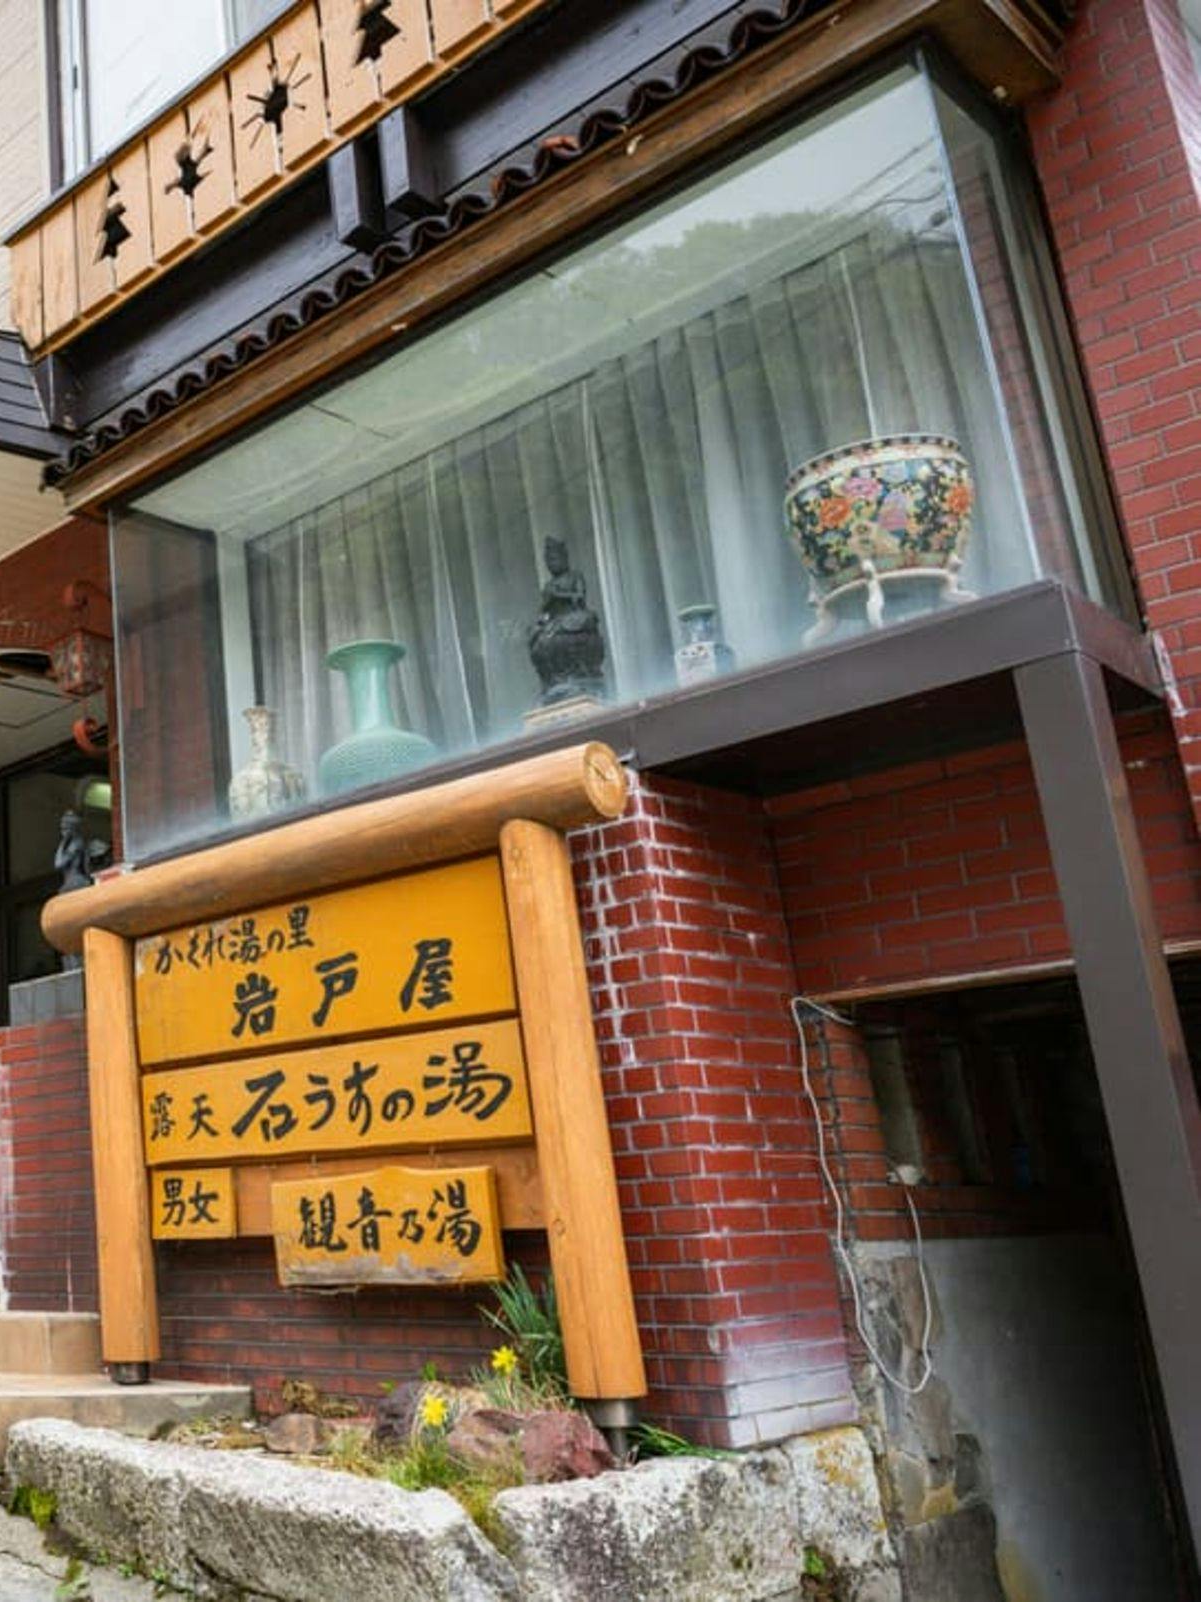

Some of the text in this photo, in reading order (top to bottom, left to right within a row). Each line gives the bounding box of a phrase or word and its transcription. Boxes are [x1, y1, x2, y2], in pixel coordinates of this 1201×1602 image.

[155, 905, 314, 975] かくれ湯の里
[231, 938, 454, 1039] 岩戸屋
[161, 1177, 220, 1227] 男女
[299, 1179, 482, 1257] 観音乃湯
